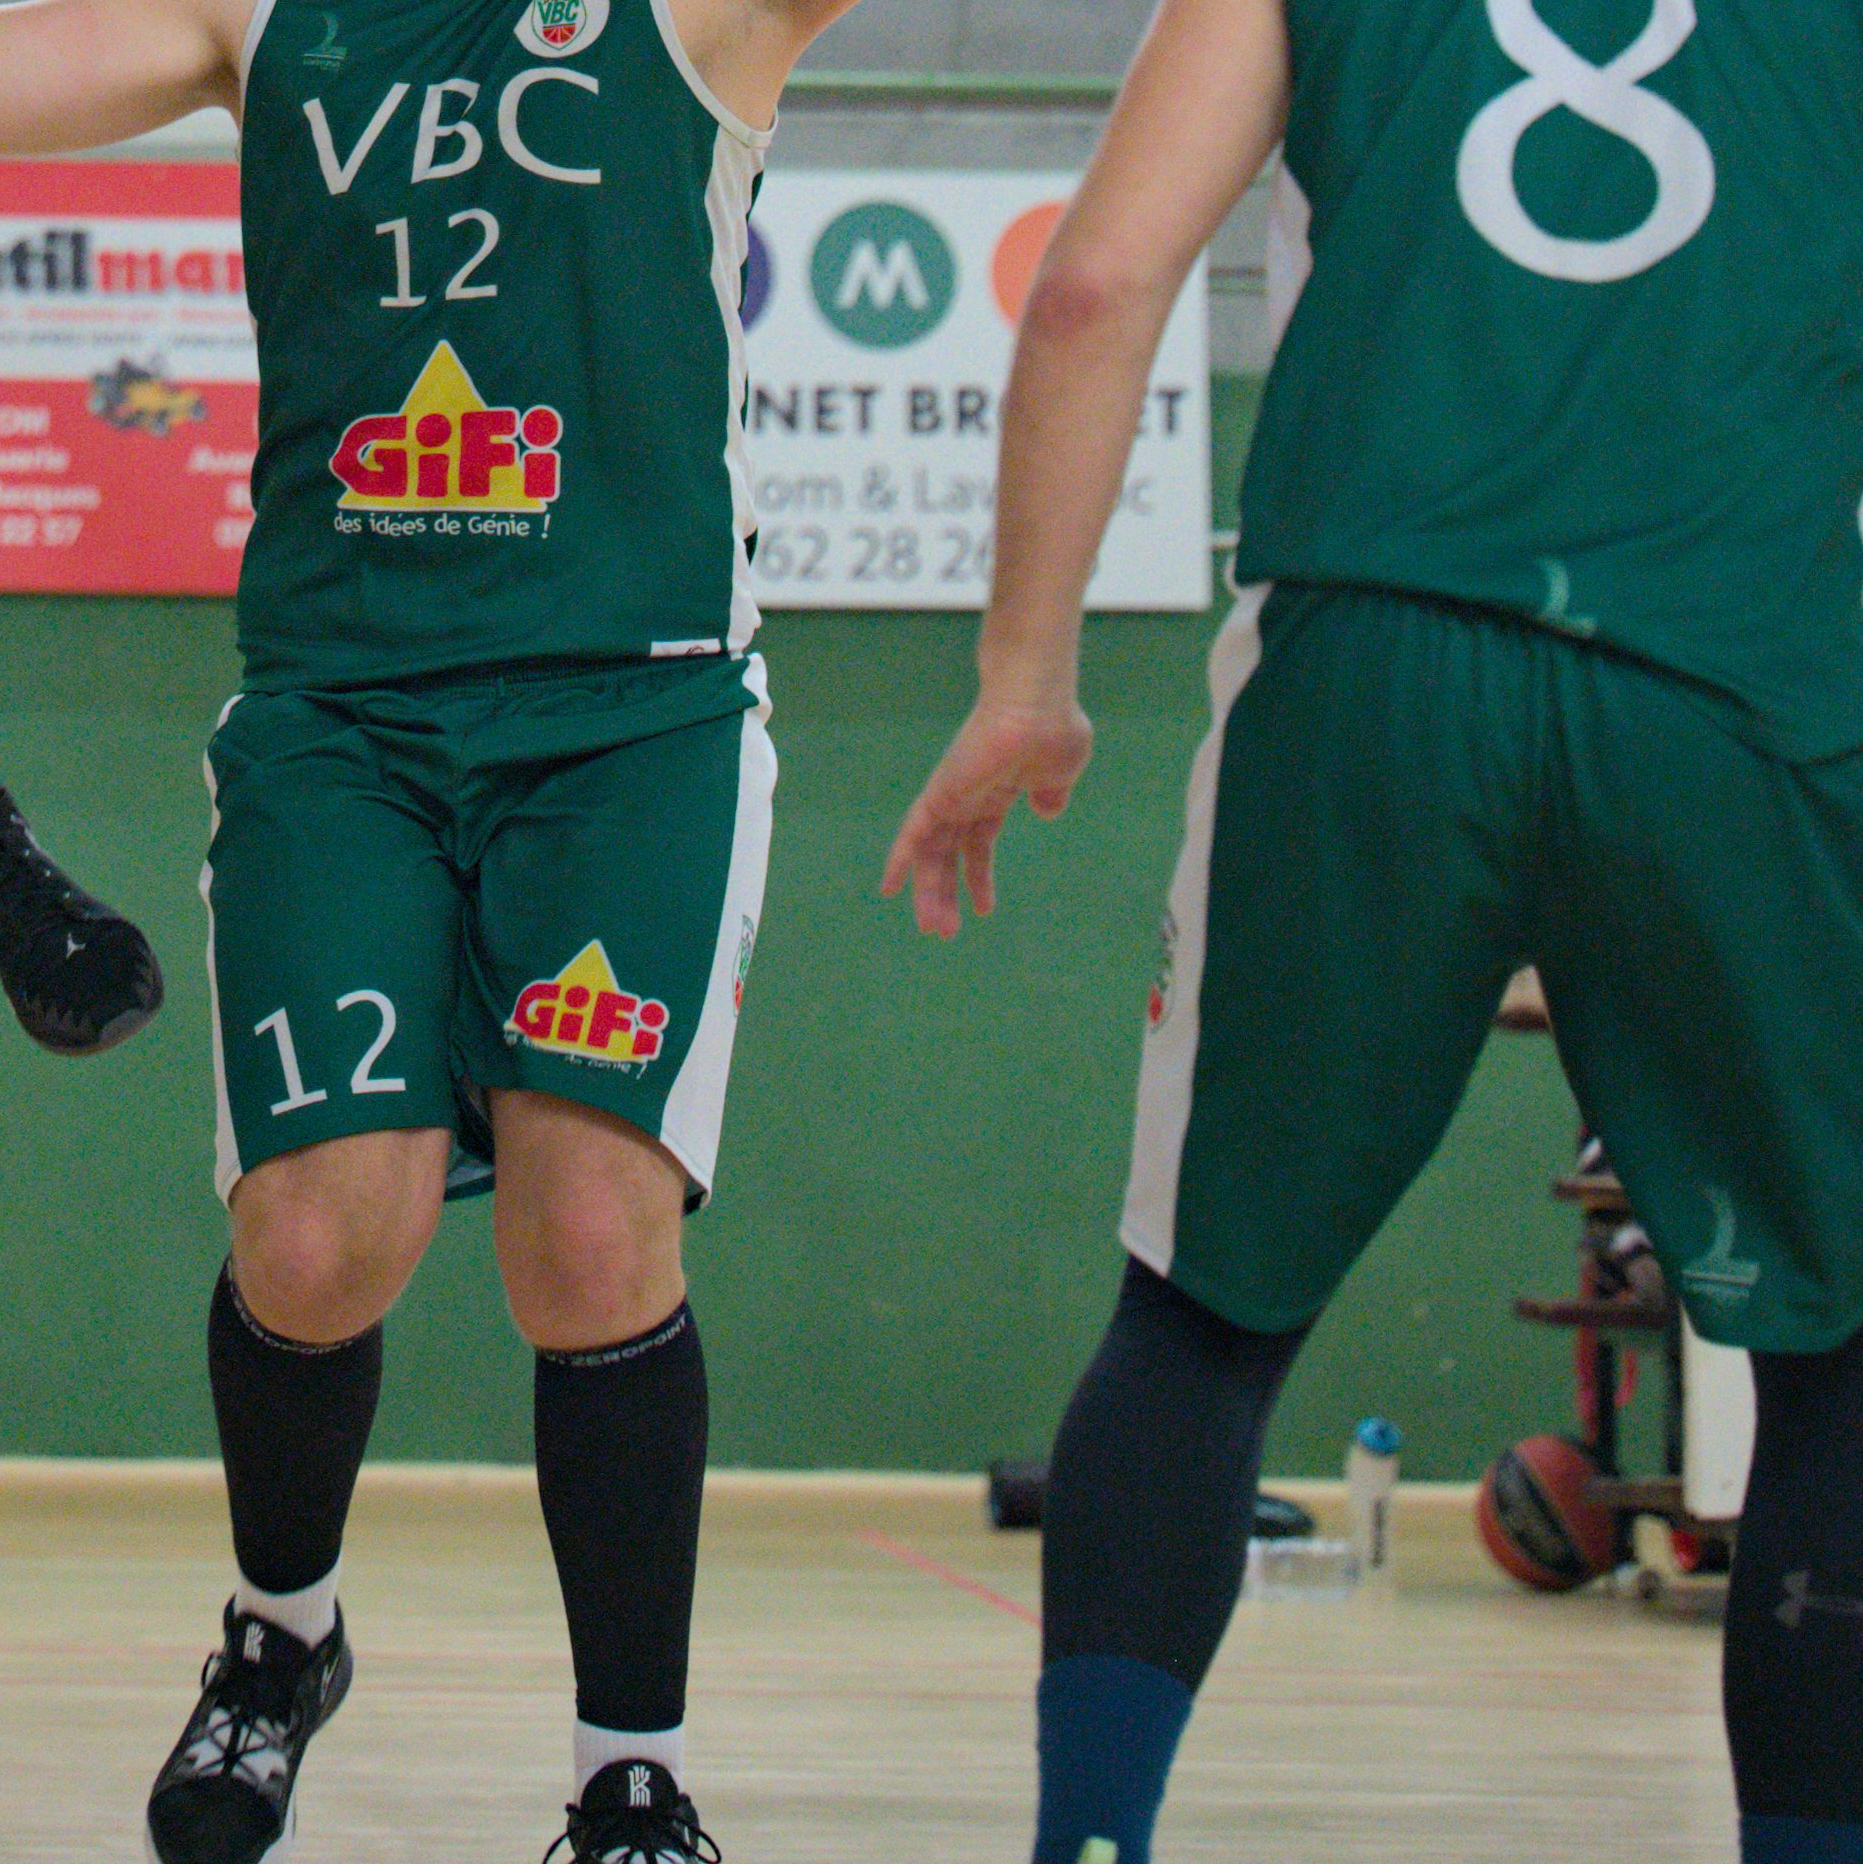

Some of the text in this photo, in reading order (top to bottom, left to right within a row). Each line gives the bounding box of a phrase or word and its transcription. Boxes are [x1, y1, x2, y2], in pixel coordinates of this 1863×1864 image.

[302, 67, 601, 195] VBC
[374, 208, 500, 308] 12
[330, 406, 562, 502] GiFi
[334, 511, 363, 534] des
[368, 511, 428, 537] idées
[434, 512, 462, 535] de
[468, 513, 532, 537] Génie
[848, 526, 924, 581] 28
[253, 988, 407, 1117] 12
[510, 978, 669, 1061] GiFi
